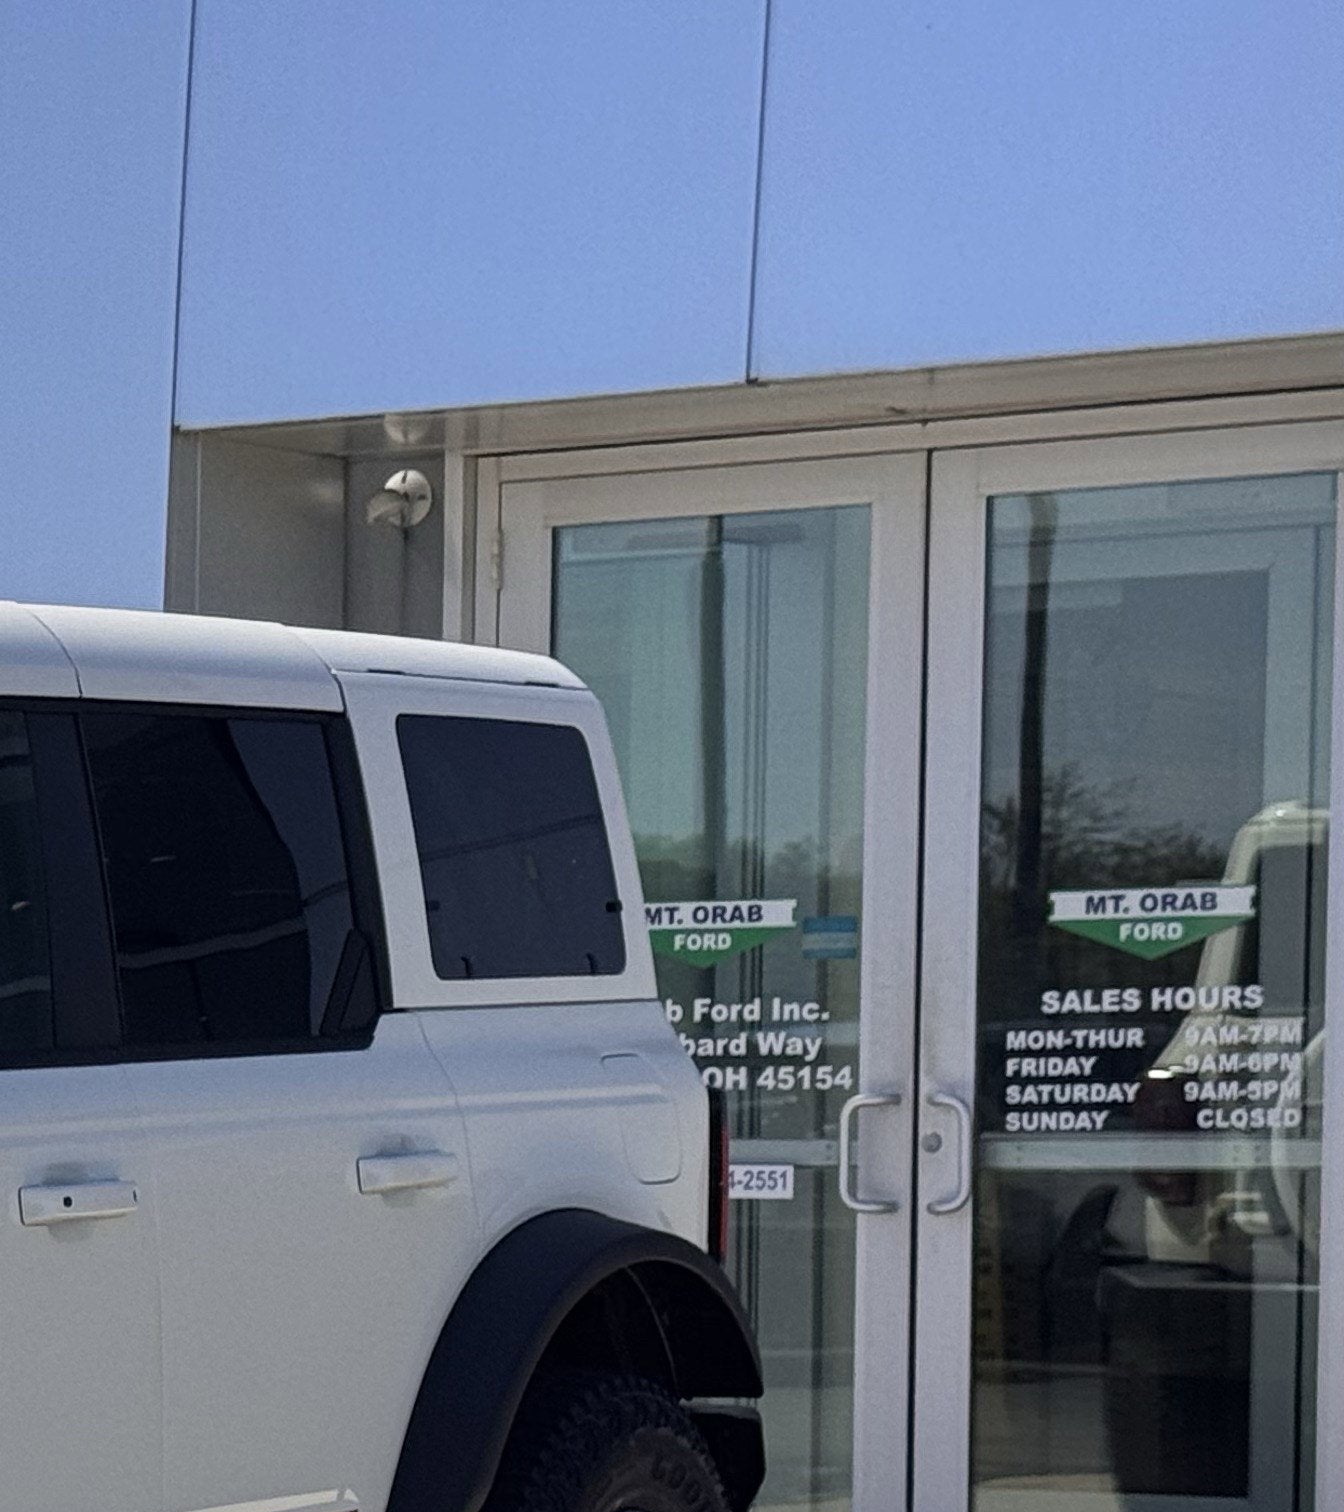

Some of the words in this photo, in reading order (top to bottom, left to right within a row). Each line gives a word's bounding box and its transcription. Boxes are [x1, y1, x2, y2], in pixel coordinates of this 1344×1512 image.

[692, 904, 764, 924] ORAB
[1084, 895, 1130, 915] MT.
[1139, 892, 1219, 912] ORAB
[673, 932, 733, 951] FORD
[1119, 922, 1184, 942] FORD
[693, 998, 762, 1022] Ford
[771, 997, 831, 1021] Inc.
[1041, 988, 1141, 1014] SALES
[1151, 985, 1264, 1011] HOURS
[756, 1031, 823, 1062] Way
[1005, 1027, 1145, 1051] MON-THUR
[1185, 1024, 1302, 1046] 9AM-7PM
[702, 1066, 748, 1090] OH
[756, 1065, 854, 1090] 45154
[1005, 1056, 1099, 1078] FRIDAY
[1005, 1082, 1142, 1106] SATURDAY
[1005, 1110, 1111, 1132] SUNDAY
[1196, 1107, 1303, 1130] CLOSED
